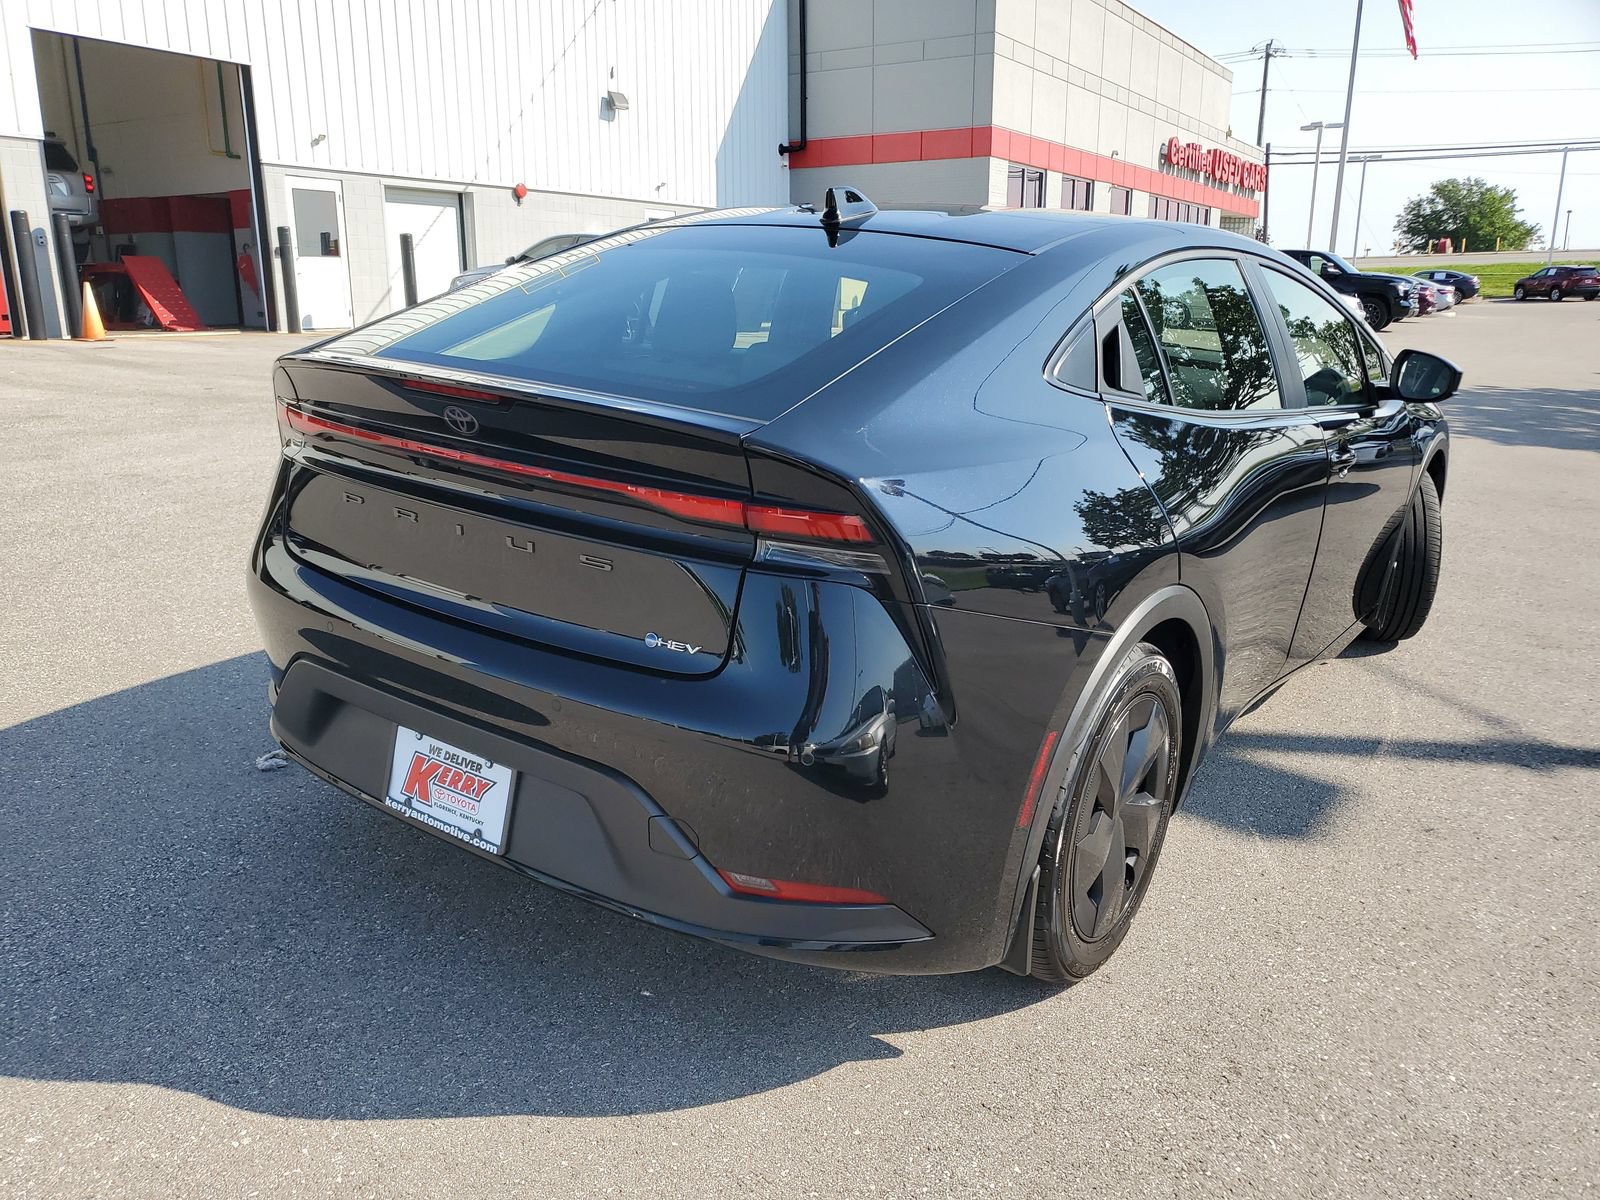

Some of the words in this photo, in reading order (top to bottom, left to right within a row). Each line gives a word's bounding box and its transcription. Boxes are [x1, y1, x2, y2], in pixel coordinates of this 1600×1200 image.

[1168, 136, 1212, 175] Certified
[1212, 148, 1242, 188] USED
[1242, 160, 1266, 192] CARS
[344, 491, 613, 571] PRIUS
[657, 637, 702, 654] HEV
[401, 751, 494, 807] KERRY
[429, 743, 443, 757] WE
[443, 750, 482, 773] DELIVER
[433, 801, 458, 817] FLORENCE,
[459, 813, 484, 827] KENTUCKY
[446, 793, 476, 812] TOYOTA
[385, 796, 498, 854] kerryautomotive.com
